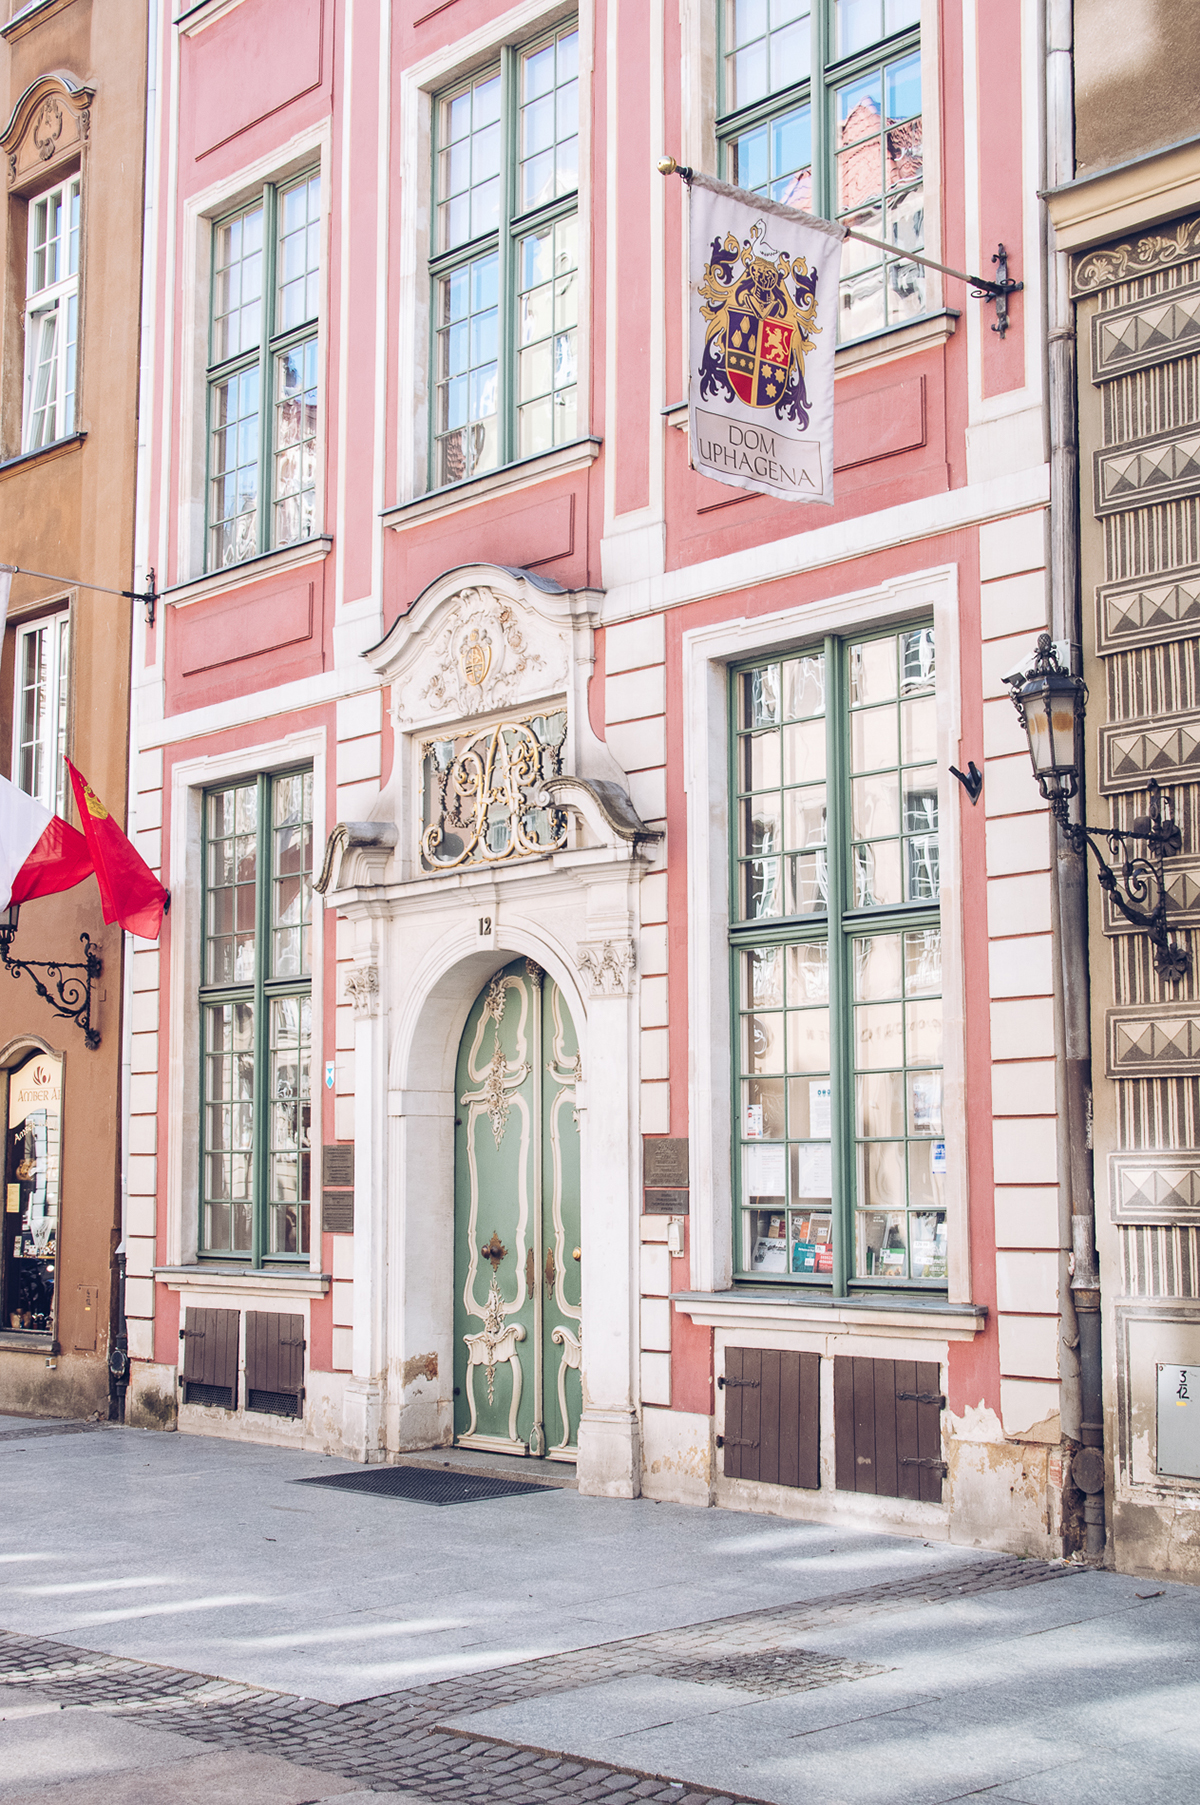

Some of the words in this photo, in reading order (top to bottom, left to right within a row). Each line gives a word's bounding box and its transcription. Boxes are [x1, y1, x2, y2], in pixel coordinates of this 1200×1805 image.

[728, 424, 776, 458] DOM
[698, 439, 815, 488] UPHAGENA
[478, 916, 492, 936] 12
[17, 1090, 49, 1102] AMBER
[1179, 1370, 1188, 1383] 3
[1176, 1386, 1190, 1400] 12
